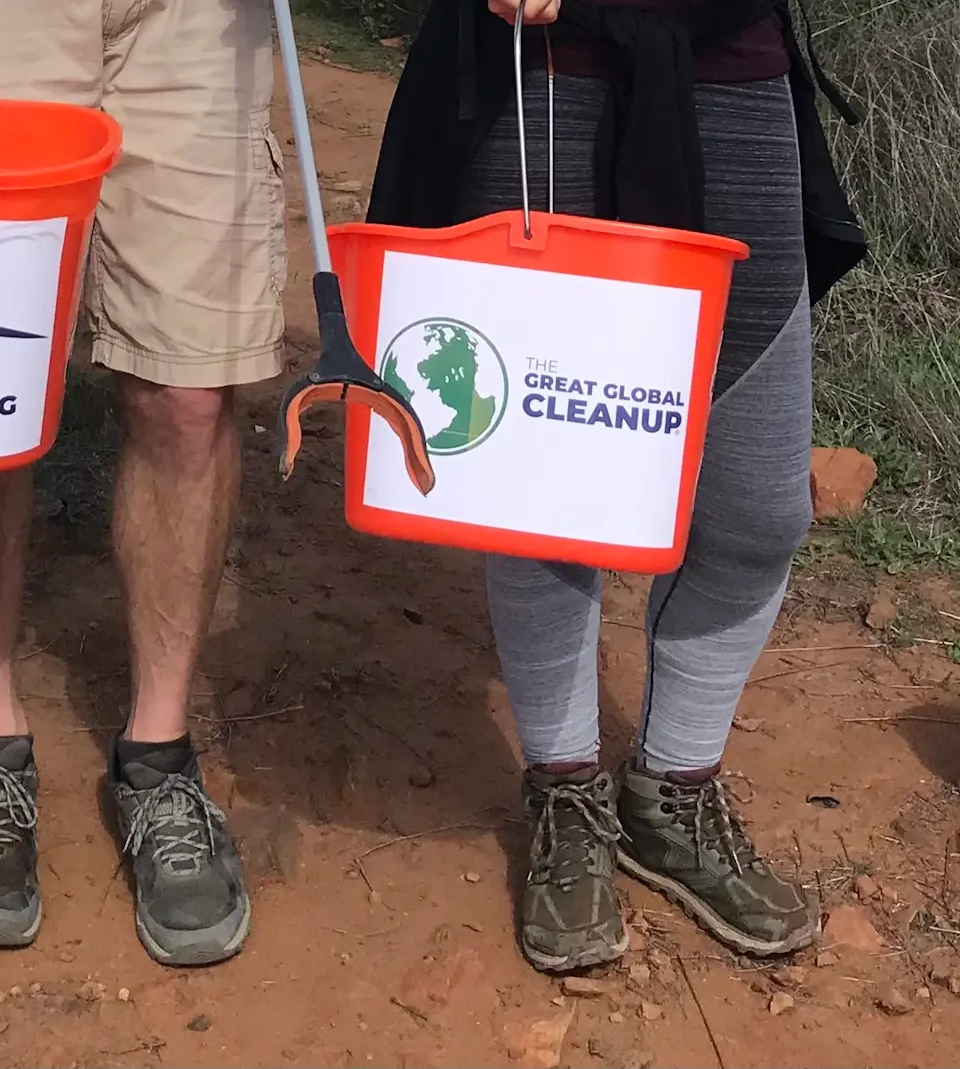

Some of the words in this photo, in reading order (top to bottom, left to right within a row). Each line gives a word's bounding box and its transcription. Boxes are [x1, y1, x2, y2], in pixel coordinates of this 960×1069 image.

[526, 356, 559, 374] THE
[524, 372, 598, 397] GREAT
[603, 383, 685, 407] GLOBAL
[522, 393, 683, 434] CLEANUP
